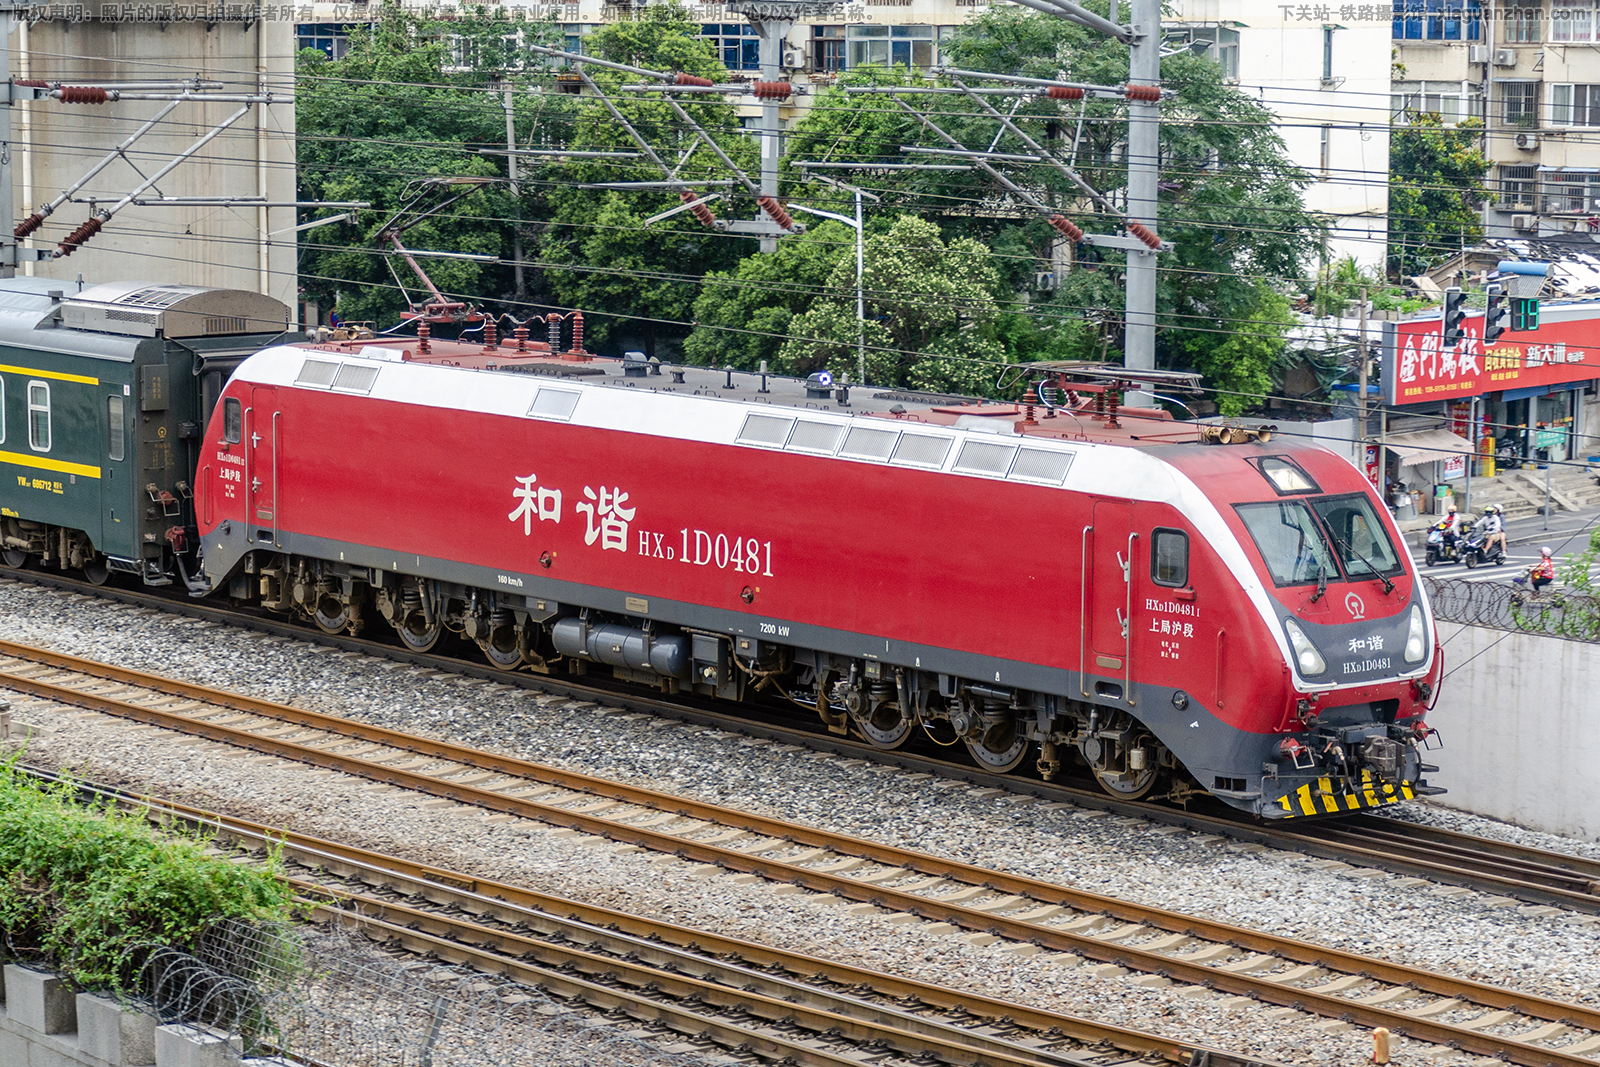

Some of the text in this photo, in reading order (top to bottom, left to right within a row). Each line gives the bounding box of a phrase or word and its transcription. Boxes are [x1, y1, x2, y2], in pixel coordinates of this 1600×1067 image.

[1521, 299, 1539, 330] 19
[508, 473, 637, 553] 和谐
[498, 575, 523, 587] 160 km/h
[759, 623, 790, 637] 7200 kW
[1149, 618, 1194, 638] 上局沪段
[1348, 635, 1384, 653] 和谐
